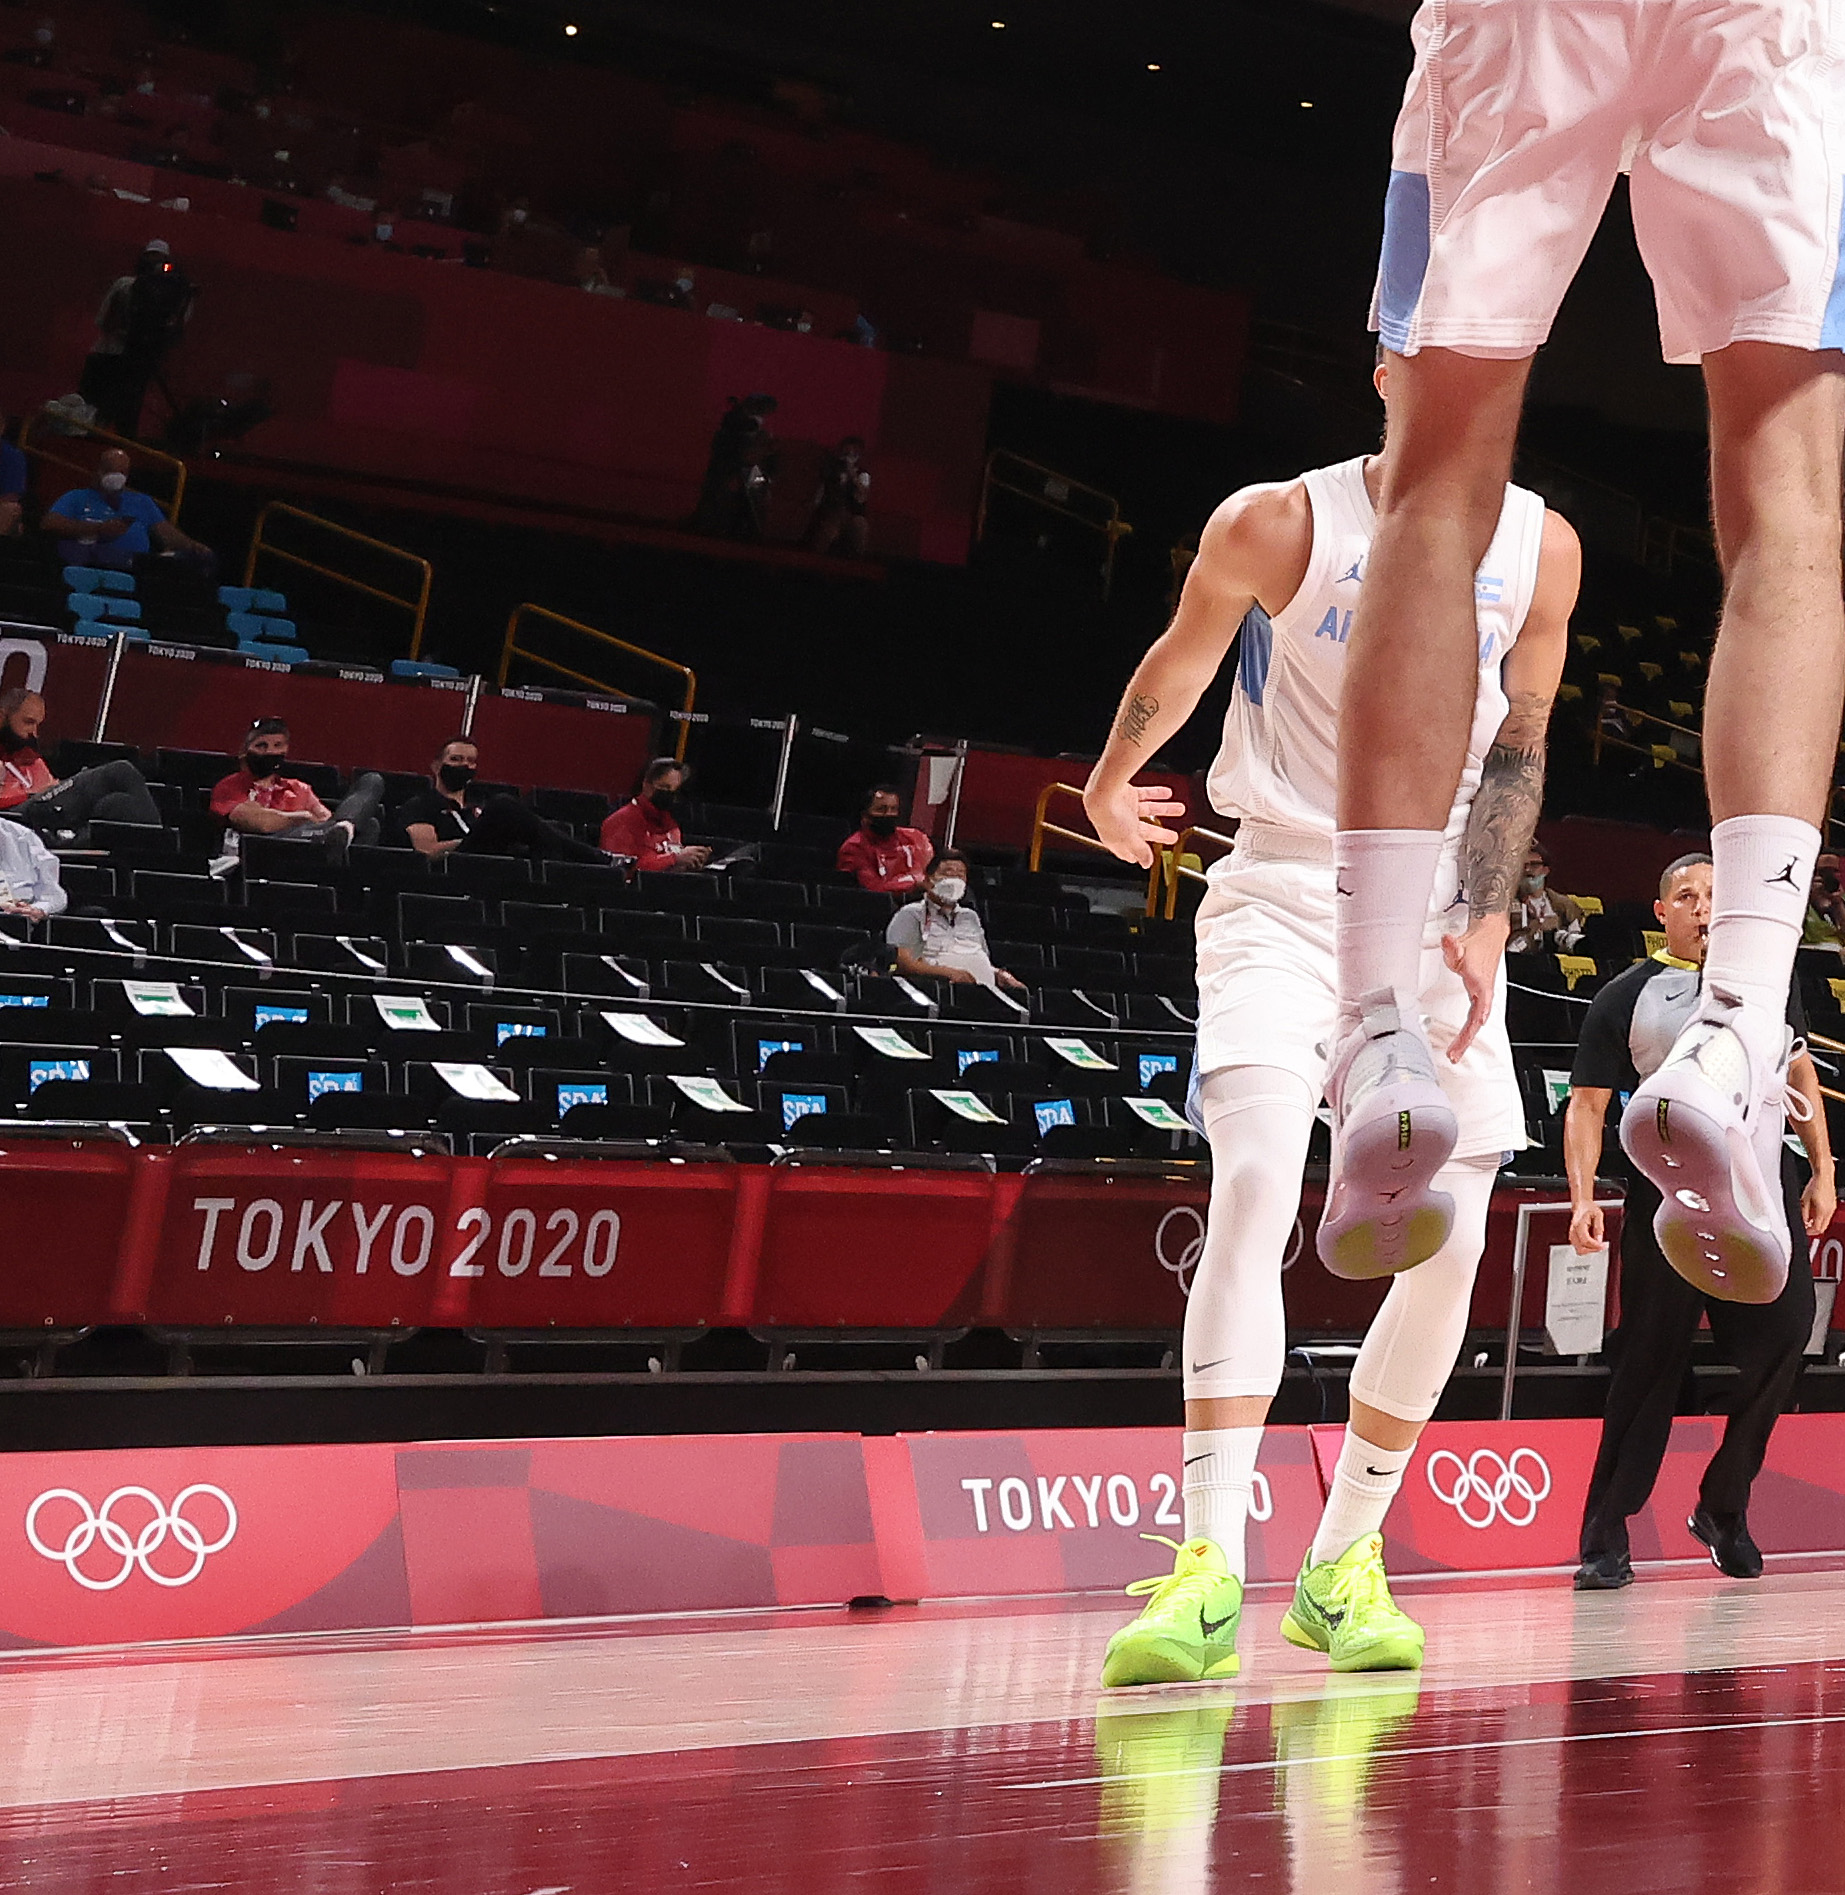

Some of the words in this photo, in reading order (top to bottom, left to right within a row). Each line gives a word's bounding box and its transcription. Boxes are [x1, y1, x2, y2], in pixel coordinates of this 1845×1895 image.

[193, 1198, 436, 1277] TOKYO
[448, 1206, 622, 1279] 2020
[961, 1474, 1139, 1533] TOKYO
[1149, 1471, 1273, 1525] 20
